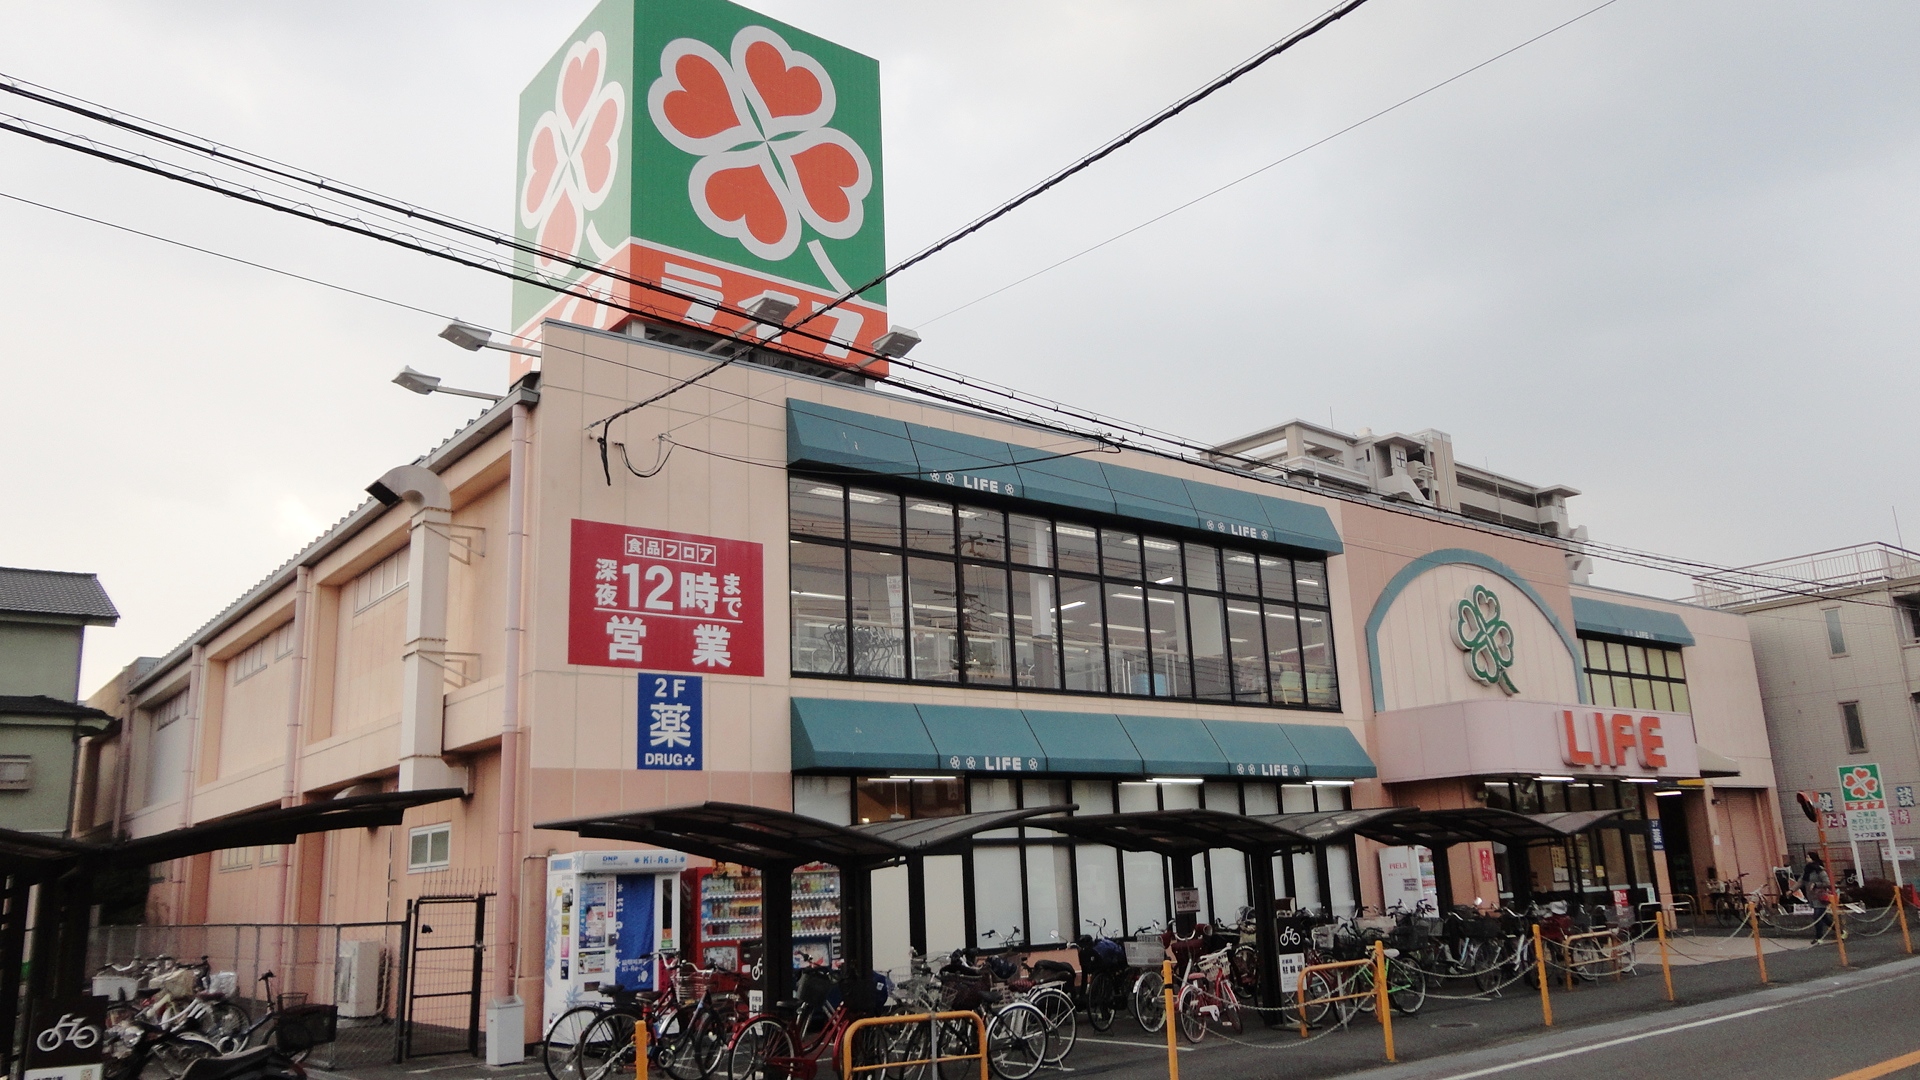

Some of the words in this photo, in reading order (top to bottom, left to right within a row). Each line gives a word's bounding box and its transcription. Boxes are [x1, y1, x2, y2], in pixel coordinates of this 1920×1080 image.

[963, 475, 999, 494] LIFE
[1231, 523, 1258, 539] LIFE
[627, 537, 714, 561] 食品フロア
[595, 558, 618, 607] 深夜
[622, 562, 719, 614] 12時
[722, 573, 742, 618] まで
[606, 615, 732, 668] 営業
[1635, 630, 1650, 640] LIFE
[654, 678, 686, 698] 2F
[650, 702, 691, 748] 薬
[1562, 709, 1668, 769] LIFE
[984, 756, 1022, 771] LIFE
[1261, 763, 1289, 777] LIFE
[1848, 800, 1880, 810] ライフ
